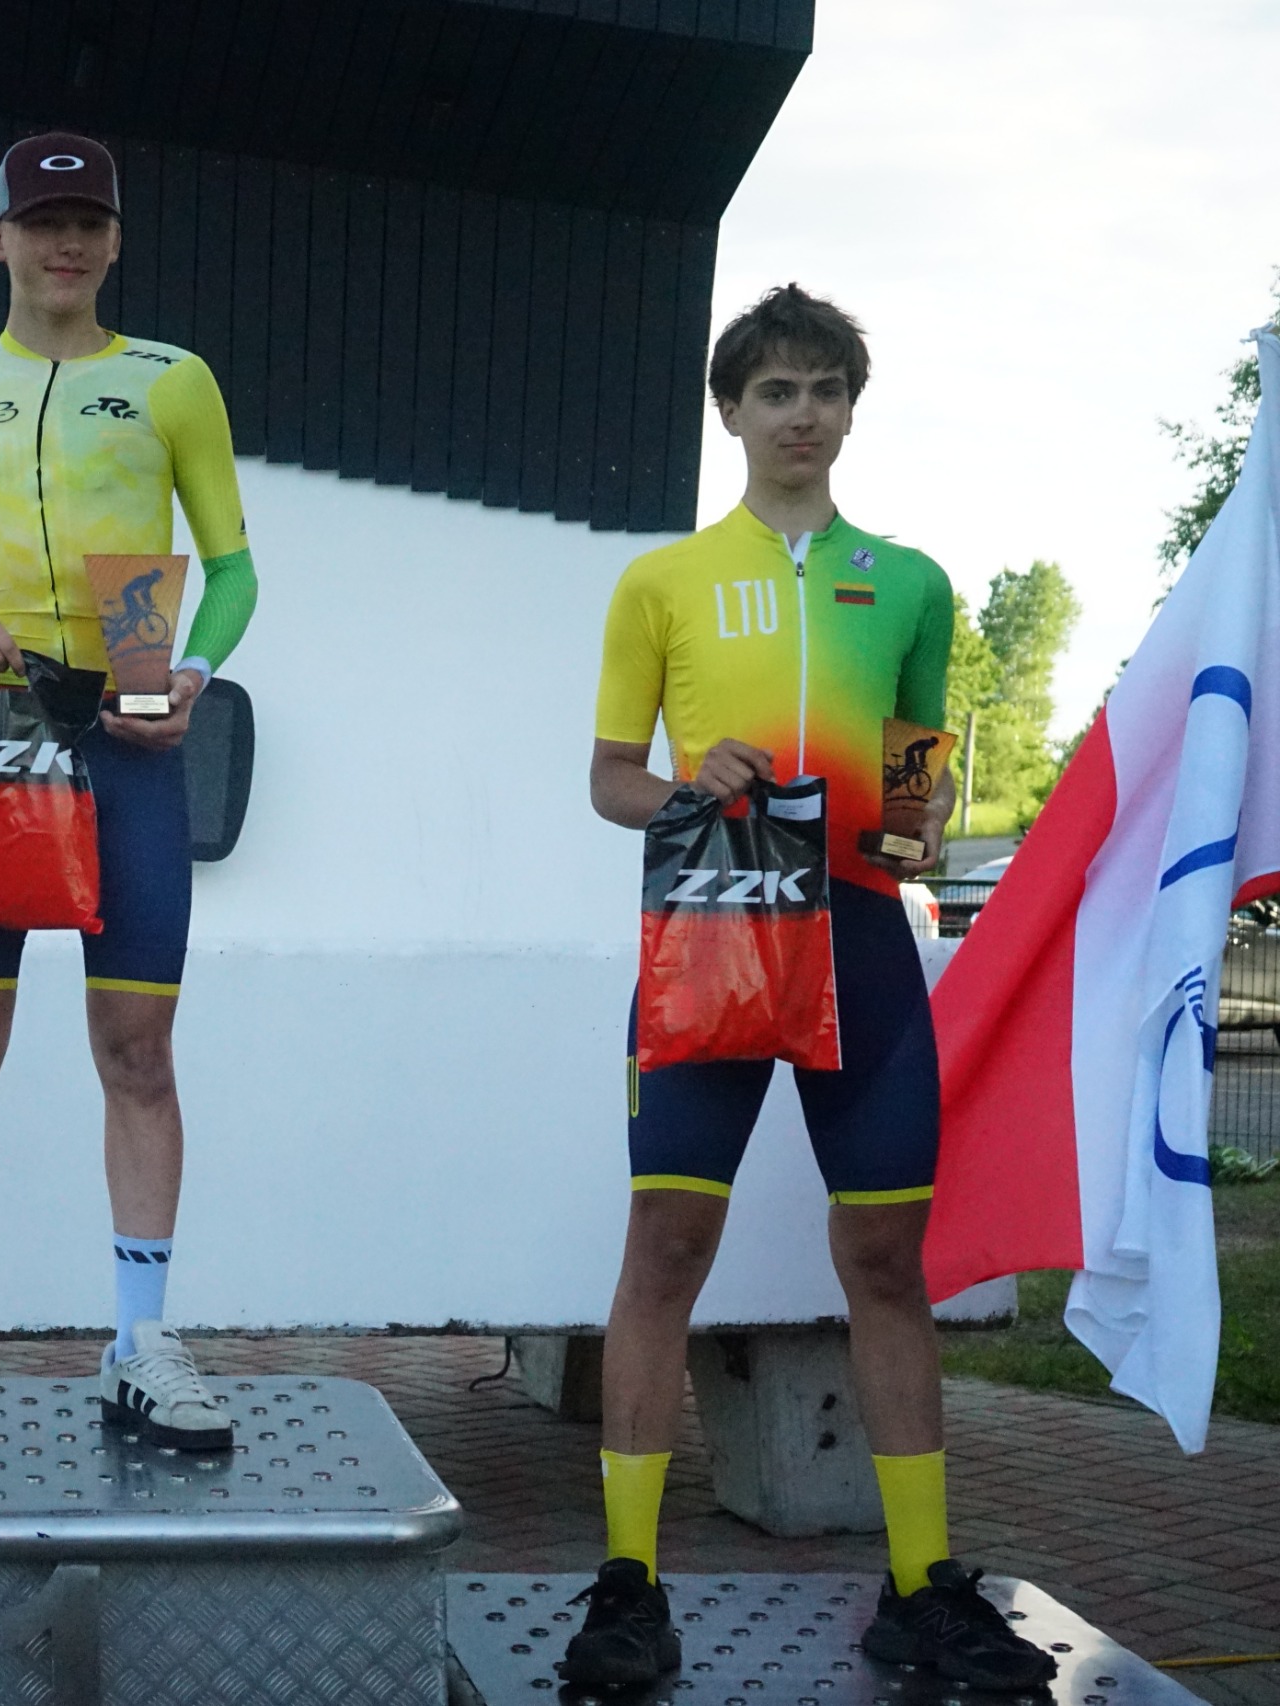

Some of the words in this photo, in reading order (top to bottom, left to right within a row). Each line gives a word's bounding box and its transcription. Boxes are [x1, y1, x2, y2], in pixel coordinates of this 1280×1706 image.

[121, 350, 180, 364] ZZK
[715, 579, 778, 638] LTU
[665, 868, 811, 904] ZZK
